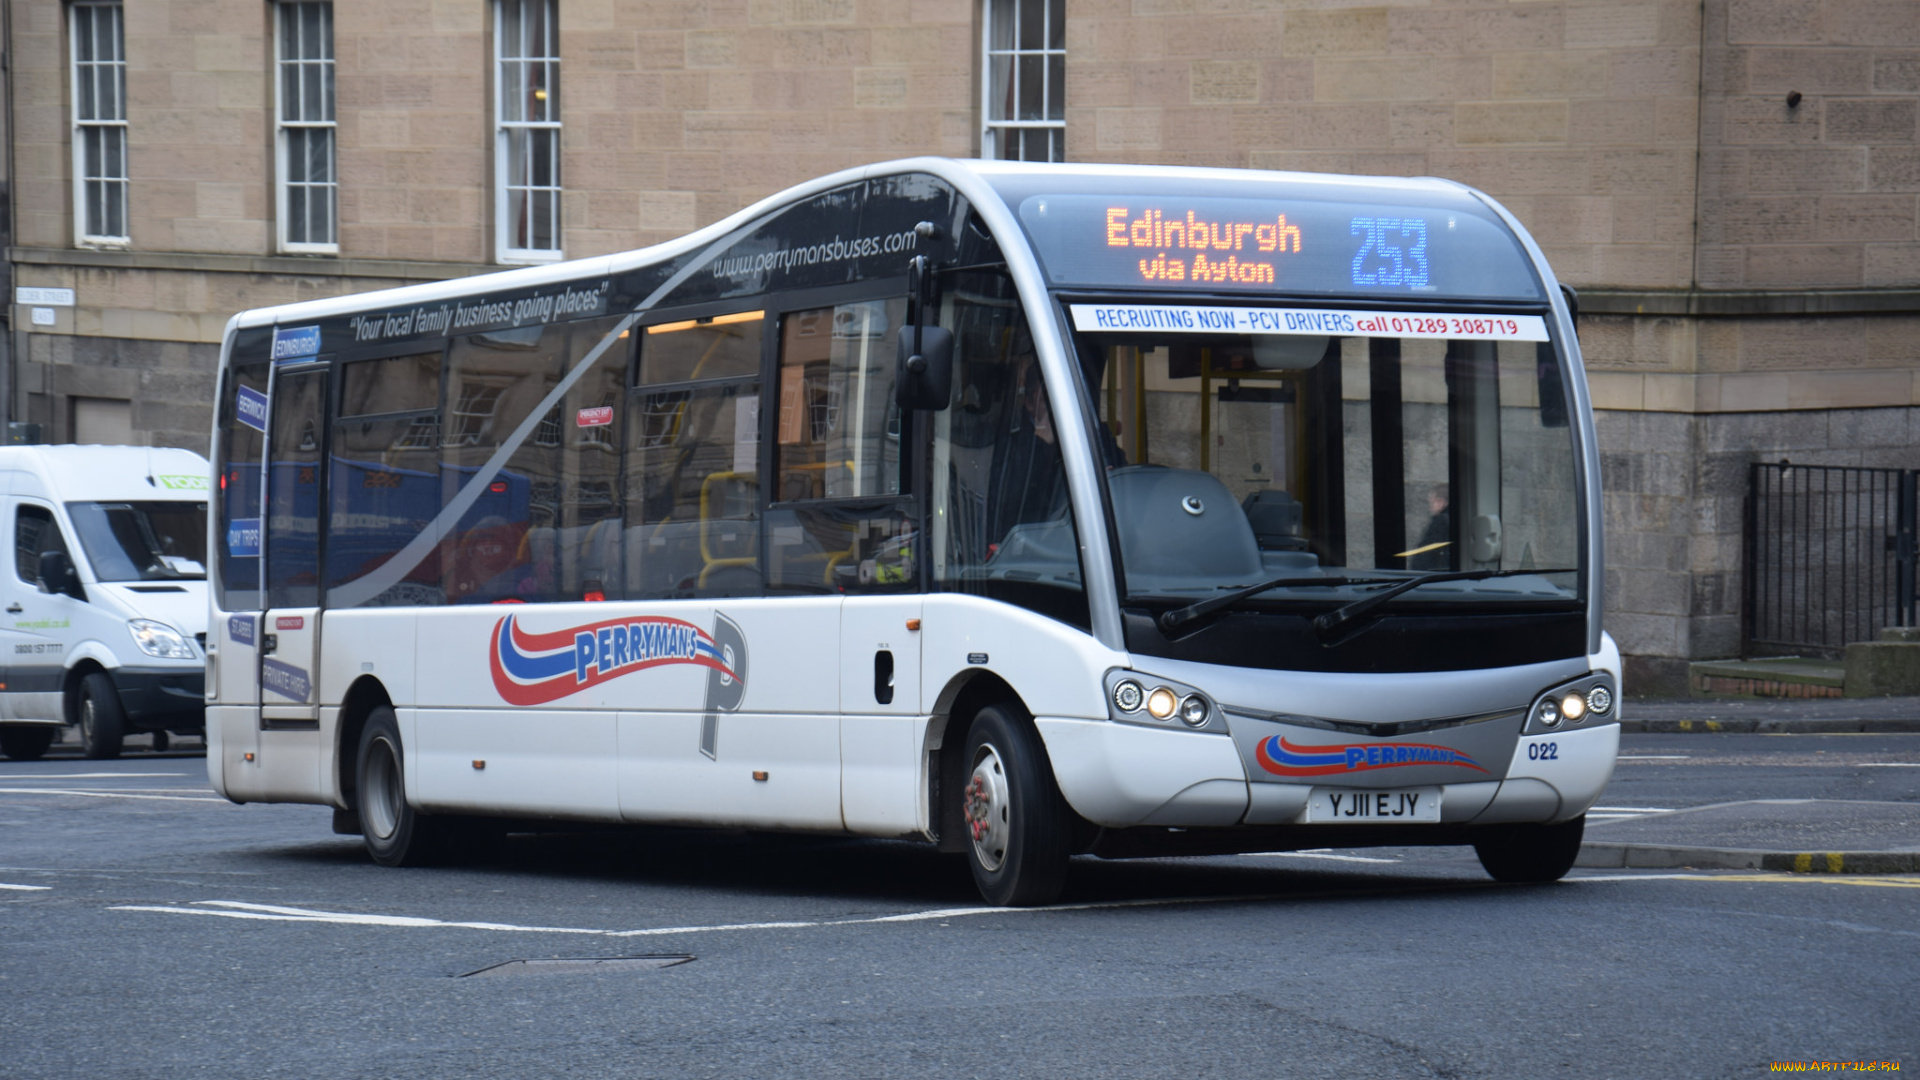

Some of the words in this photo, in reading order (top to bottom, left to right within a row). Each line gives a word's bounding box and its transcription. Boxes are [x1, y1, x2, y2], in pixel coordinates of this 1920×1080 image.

[1107, 208, 1301, 253] Edinburgh
[713, 231, 917, 279] www.perrymansbuses.com
[1350, 217, 1428, 287] 253
[1139, 253, 1186, 280] via
[1191, 254, 1275, 284] Ayton
[383, 309, 414, 338] local
[414, 307, 453, 337] family
[454, 299, 512, 328] business
[514, 291, 554, 327] going
[1095, 309, 1194, 329] RECRUITING
[1197, 310, 1236, 329] NOW
[1250, 311, 1280, 330] PCV
[1285, 312, 1355, 332] DRIVERS
[1356, 316, 1388, 332] call
[1391, 317, 1448, 334] 01289
[1451, 318, 1519, 335] 308719
[276, 336, 317, 357] EDINBURGH
[239, 394, 265, 420] BERWICK
[161, 476, 210, 489] YODE
[229, 530, 241, 546] DAY
[242, 529, 259, 546] TRIPS
[262, 664, 290, 690] PRIVATE
[290, 675, 306, 697] HIRE
[1528, 742, 1558, 761] 022
[1329, 793, 1370, 817] YJ11
[1376, 793, 1419, 817] EJY
